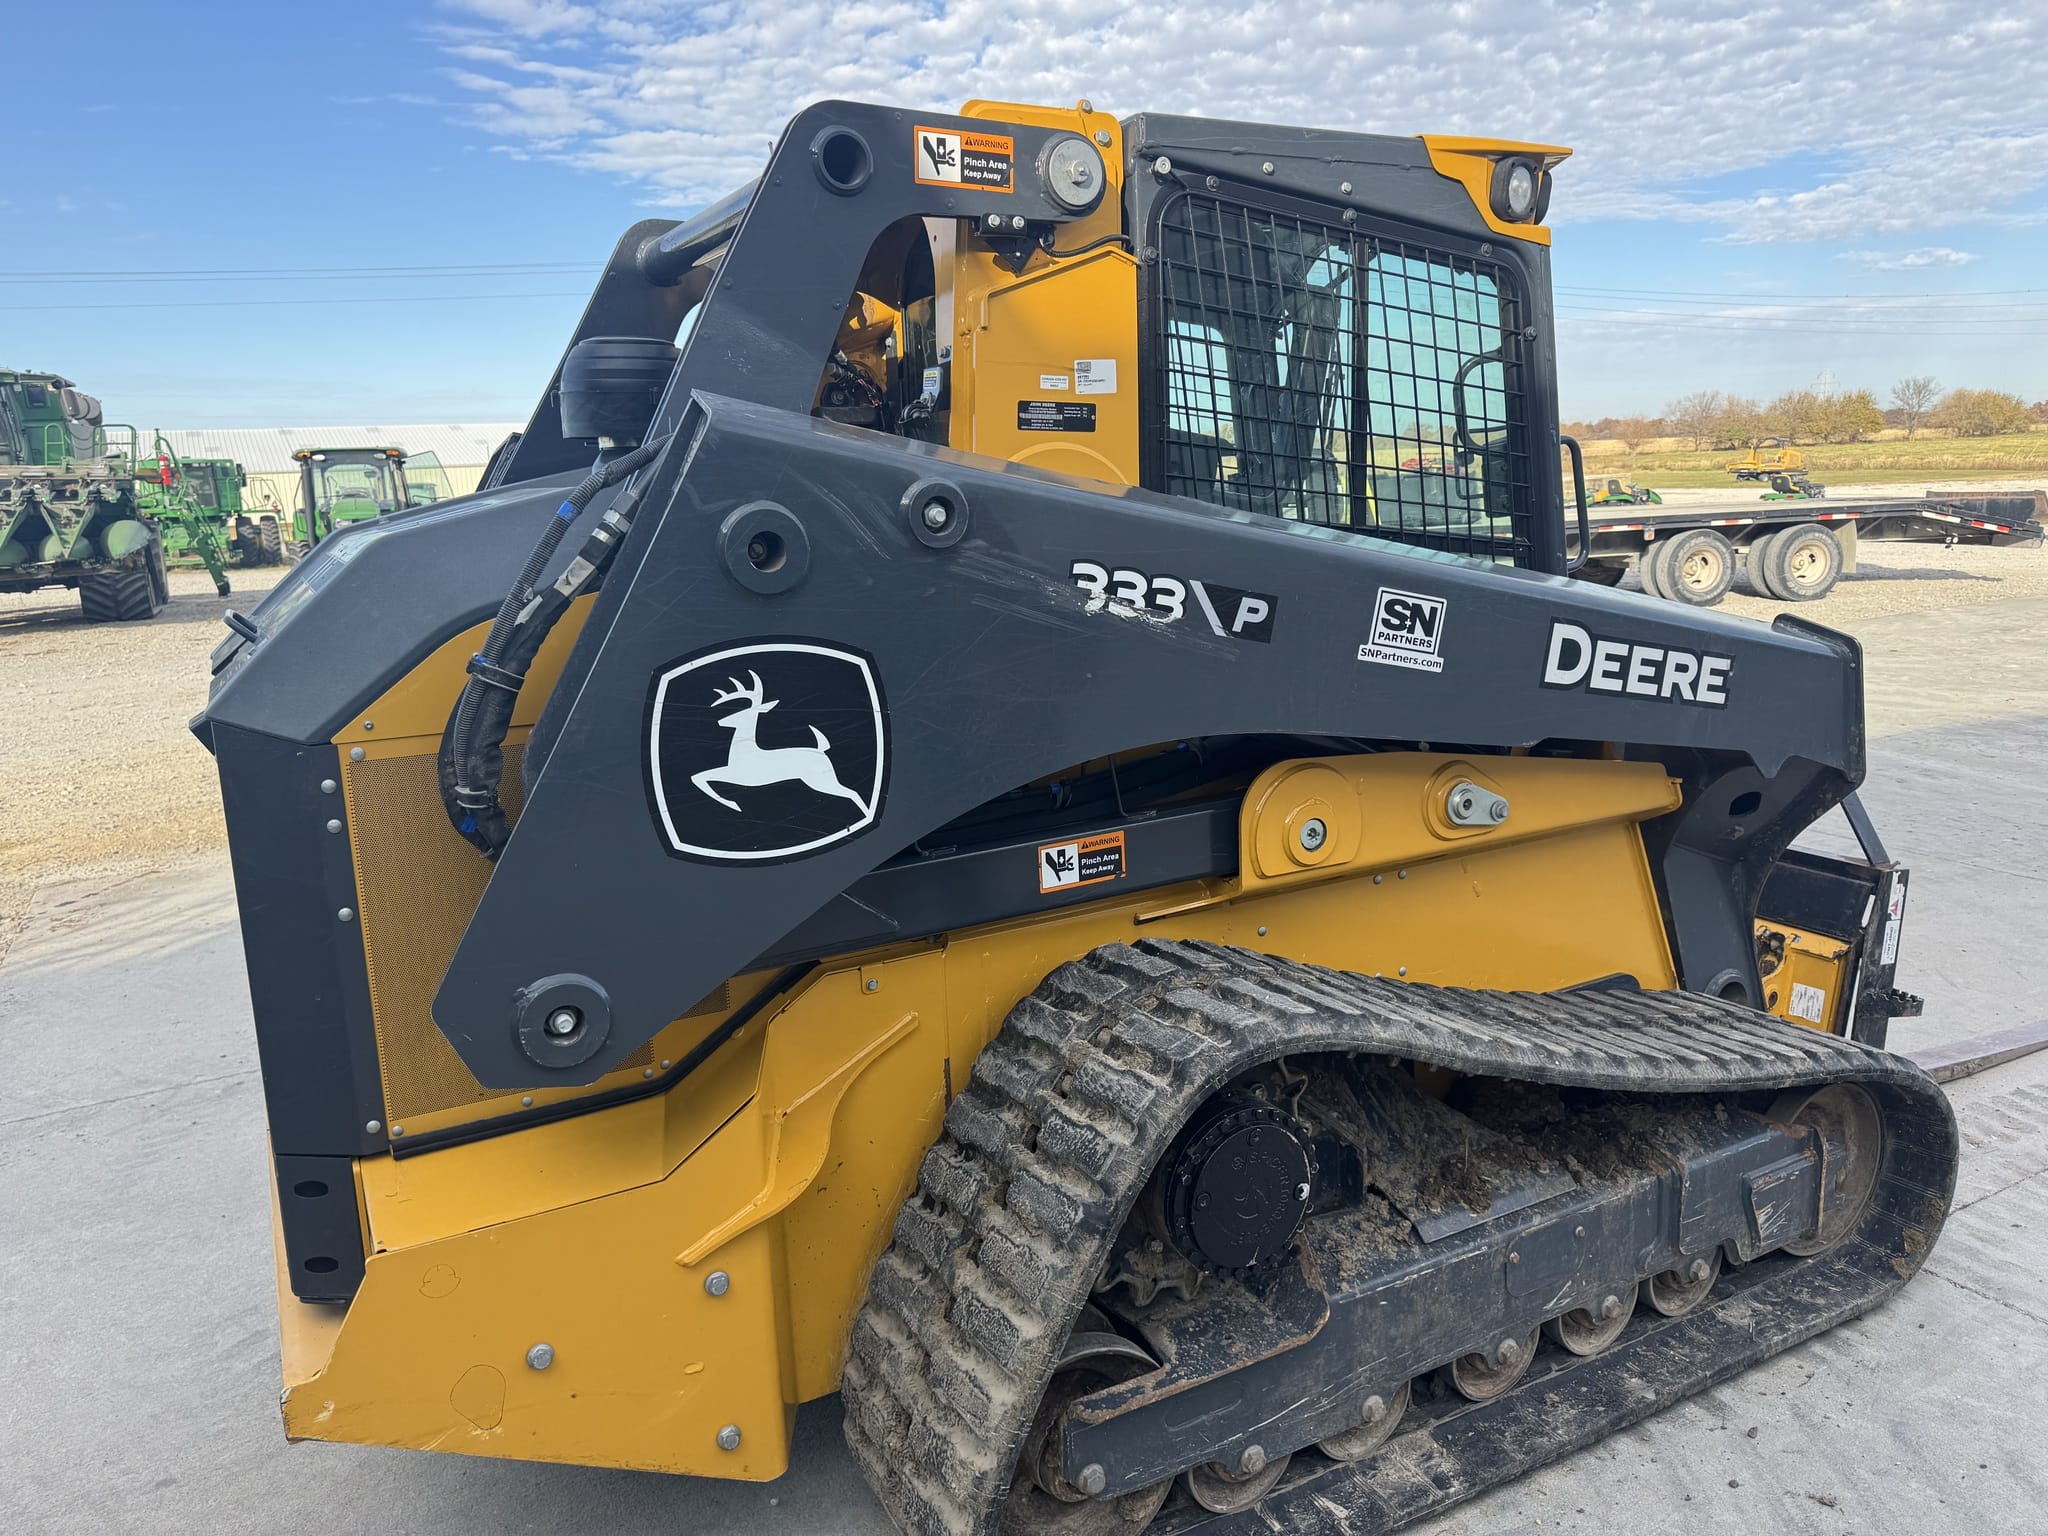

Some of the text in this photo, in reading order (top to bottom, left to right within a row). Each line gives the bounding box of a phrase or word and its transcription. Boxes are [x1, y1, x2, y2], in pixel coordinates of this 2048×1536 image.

[972, 138, 1009, 150] WARNING
[964, 156, 1007, 170] Pinch Area
[964, 168, 1002, 182] Keep Away
[1072, 562, 1186, 624] 333
[1378, 631, 1433, 649] PARTNERS
[1360, 647, 1442, 669] SNPartners.com
[1543, 622, 1732, 705] DEERE
[1088, 836, 1120, 848] WARNING
[1081, 853, 1120, 866] Pinch Area
[1081, 864, 1115, 876] Keep Away
